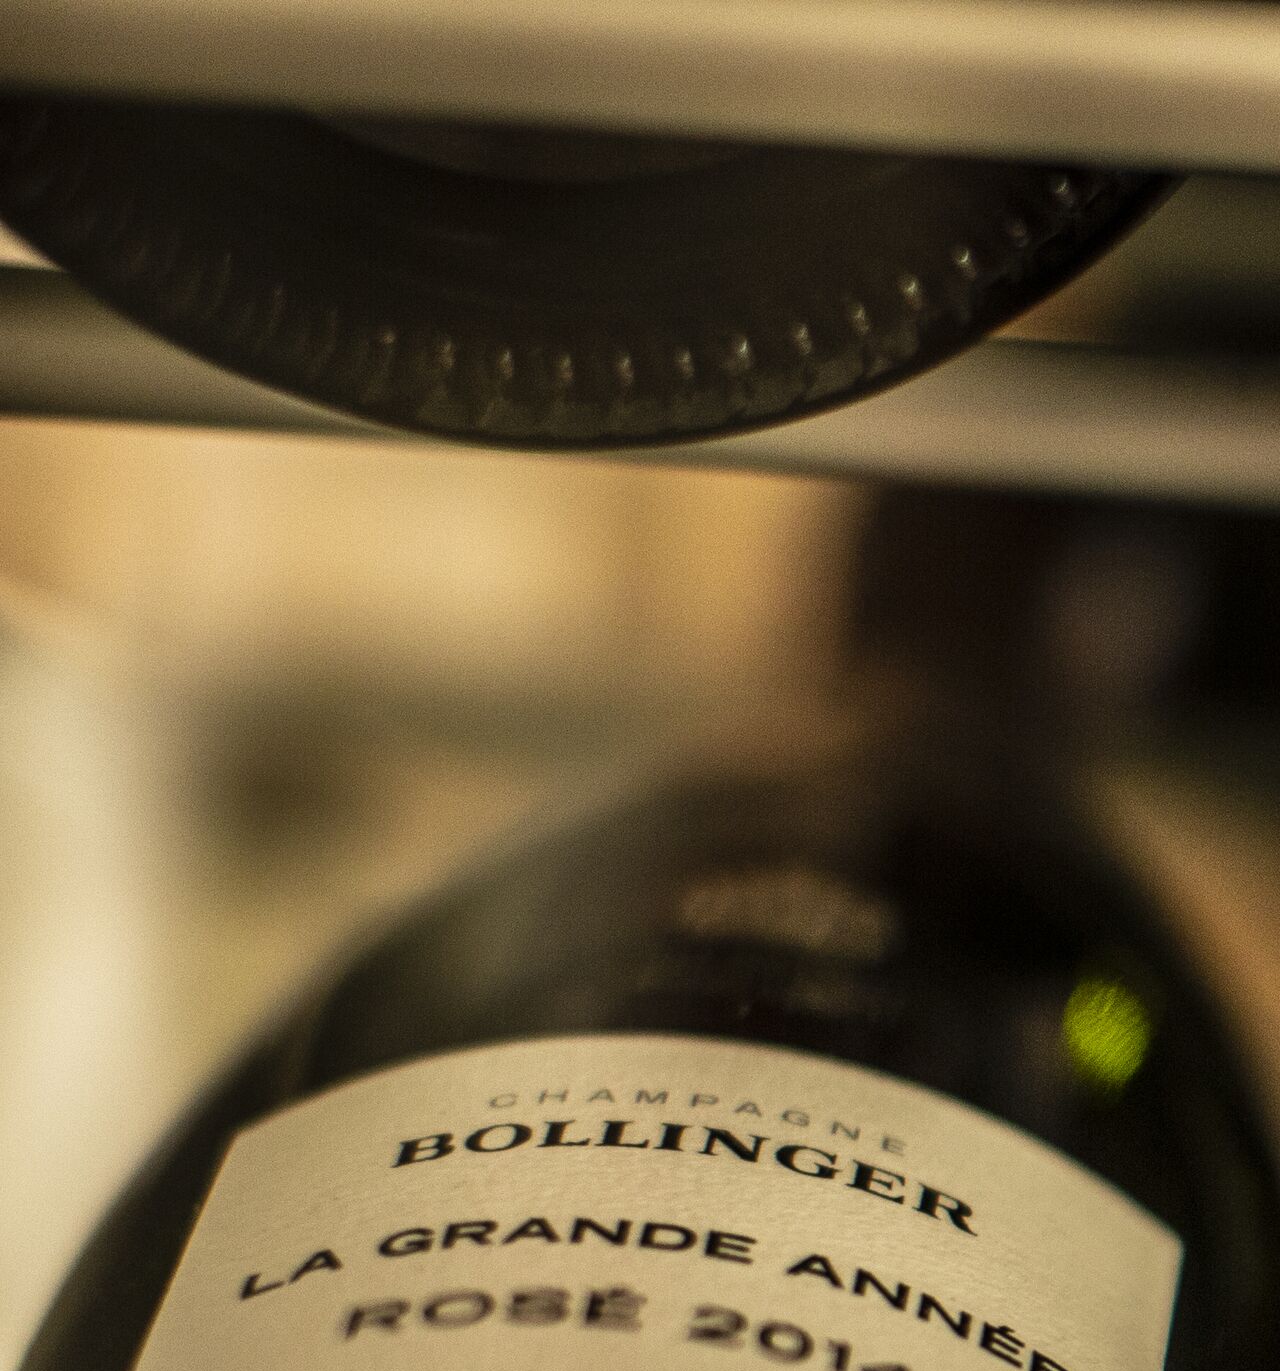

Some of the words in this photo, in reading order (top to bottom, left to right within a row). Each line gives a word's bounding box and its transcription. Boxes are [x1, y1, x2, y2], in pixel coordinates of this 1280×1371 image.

[489, 1087, 907, 1156] CHAMPAGNE
[390, 1118, 978, 1237] BOLLINGER
[237, 1246, 344, 1302] LA
[375, 1214, 758, 1266] GRANDE
[340, 1284, 648, 1342] ROSÉ
